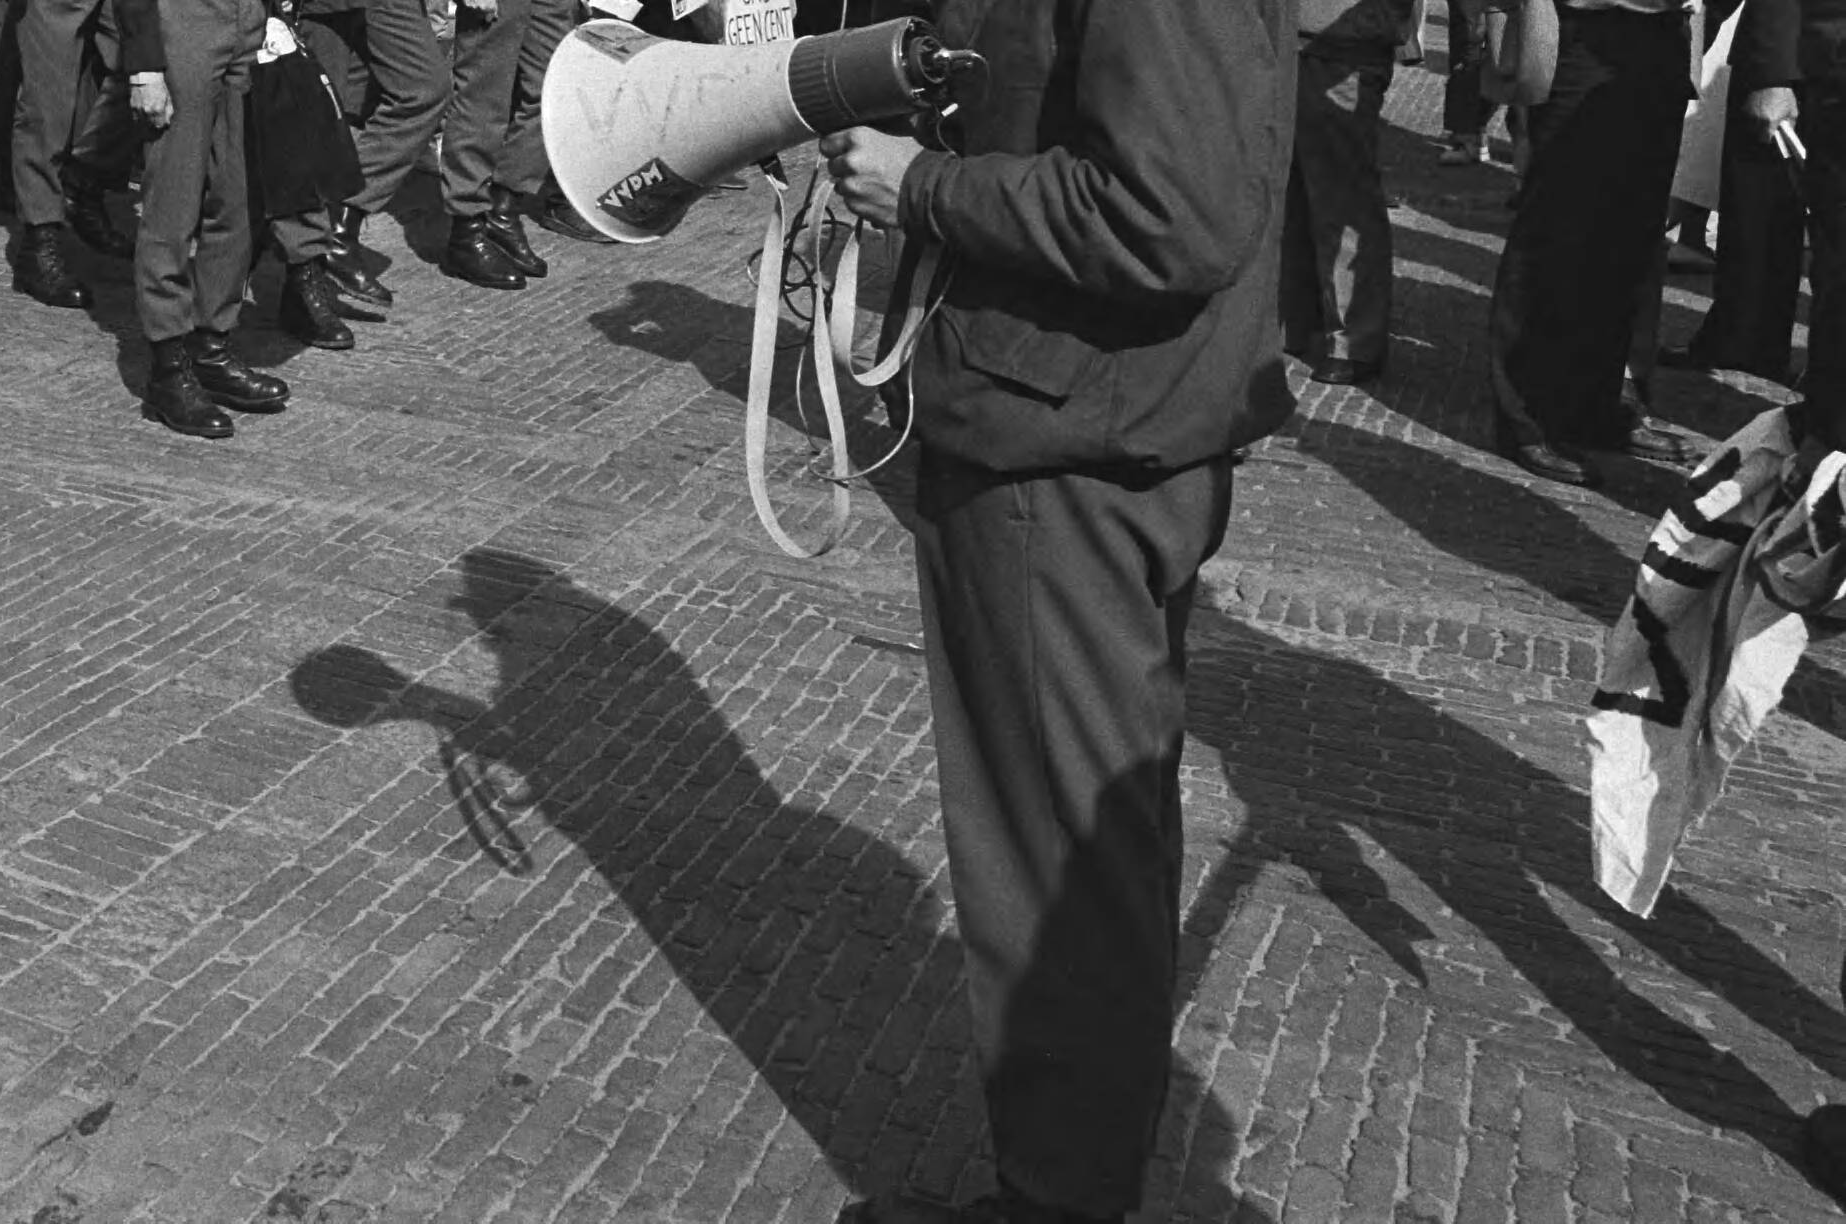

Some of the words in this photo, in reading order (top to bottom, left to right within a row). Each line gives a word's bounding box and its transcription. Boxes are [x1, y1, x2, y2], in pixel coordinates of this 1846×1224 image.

[727, 8, 763, 47] GEEN
[764, 4, 791, 42] CENT
[603, 162, 664, 208] VVDM
